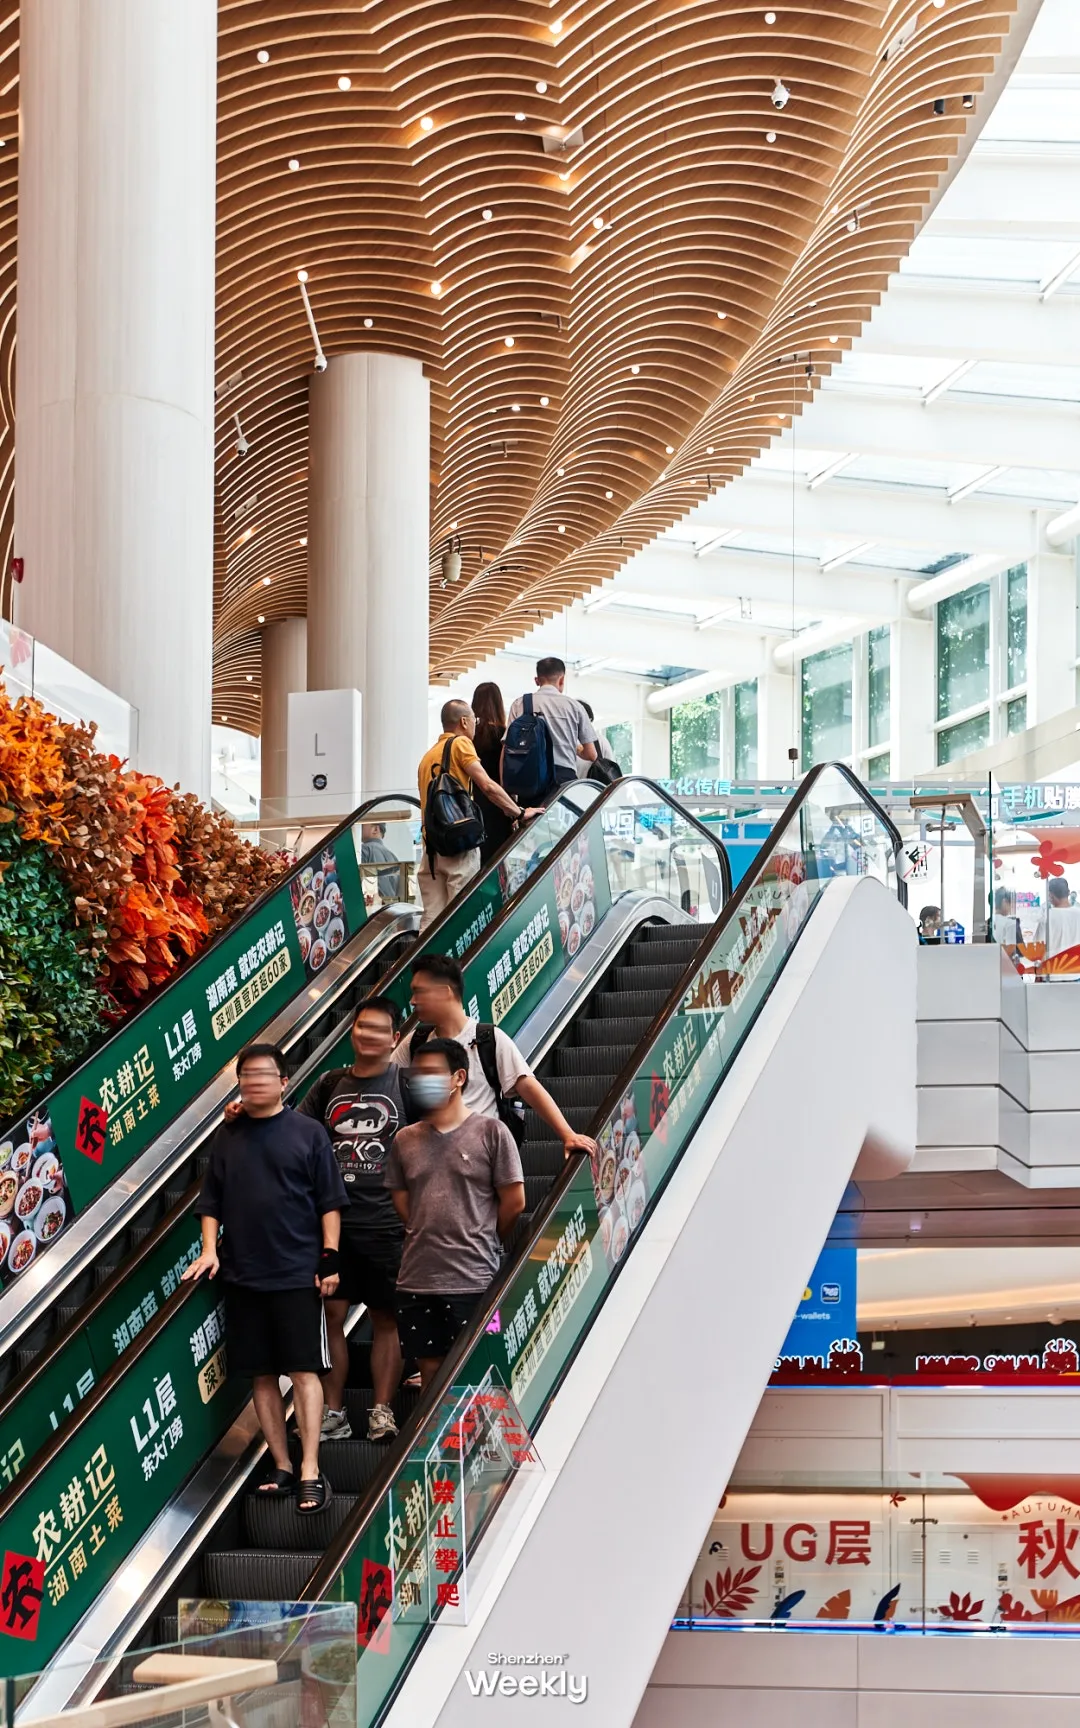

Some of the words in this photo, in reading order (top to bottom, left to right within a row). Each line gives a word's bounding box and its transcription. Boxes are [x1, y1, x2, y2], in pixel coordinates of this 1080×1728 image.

[315, 733, 326, 756] L
[658, 777, 731, 796] 文化传信
[206, 965, 238, 1011] 湖南菜
[238, 920, 286, 980] 就吃农耕记
[487, 950, 512, 997] 湖南菜
[512, 904, 550, 964] 就吃农耕记
[216, 953, 288, 1033] 深圳直营店超60家
[164, 1009, 198, 1060] L1层
[663, 1016, 697, 1091] 农耕记
[99, 1044, 154, 1114] 农耕记
[109, 1083, 161, 1146] 湖南土菜
[504, 1288, 538, 1364] 湖南菜
[537, 1204, 586, 1305] 就吃农耕记
[112, 1290, 158, 1356] 湖南菜
[130, 1373, 177, 1453] L1层
[141, 1416, 184, 1481] 东大门旁
[32, 1444, 115, 1562] 农耕记
[48, 1495, 124, 1606] 湖南土菜
[433, 1480, 460, 1607] 禁止攀爬
[741, 1521, 871, 1565] UG层
[1017, 1519, 1080, 1579] 秋
